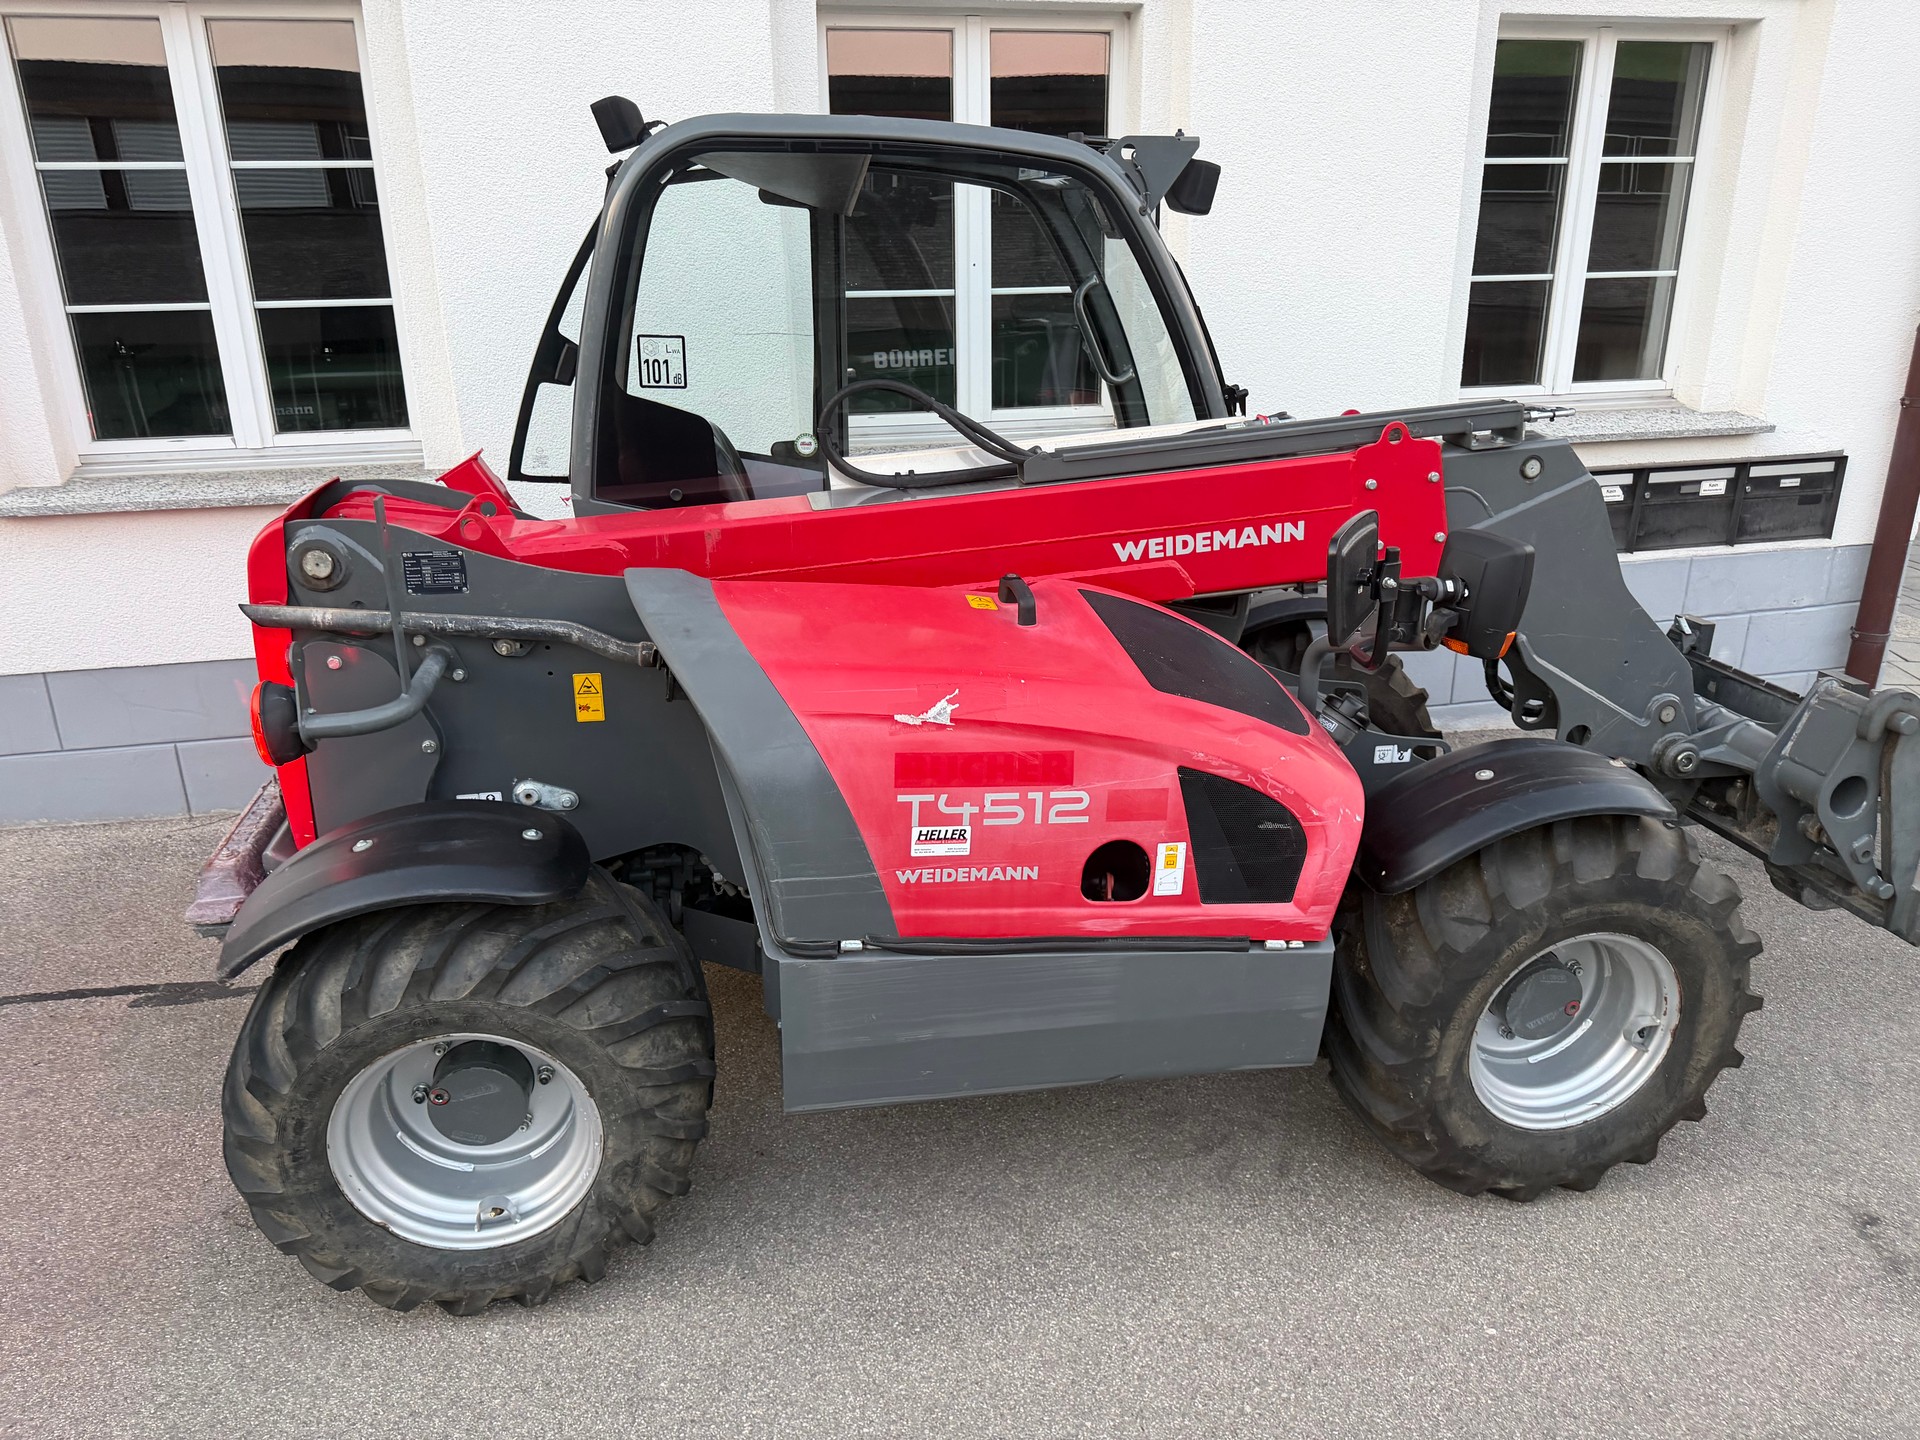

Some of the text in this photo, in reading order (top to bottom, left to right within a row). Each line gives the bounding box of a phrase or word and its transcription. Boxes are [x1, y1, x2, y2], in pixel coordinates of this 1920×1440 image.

[643, 358, 682, 385] 101 dB
[1112, 520, 1305, 563] WEIDEMANN
[897, 790, 1091, 828] T4512
[917, 828, 967, 841] HELLER
[896, 866, 1039, 884] WEIDEMANN
